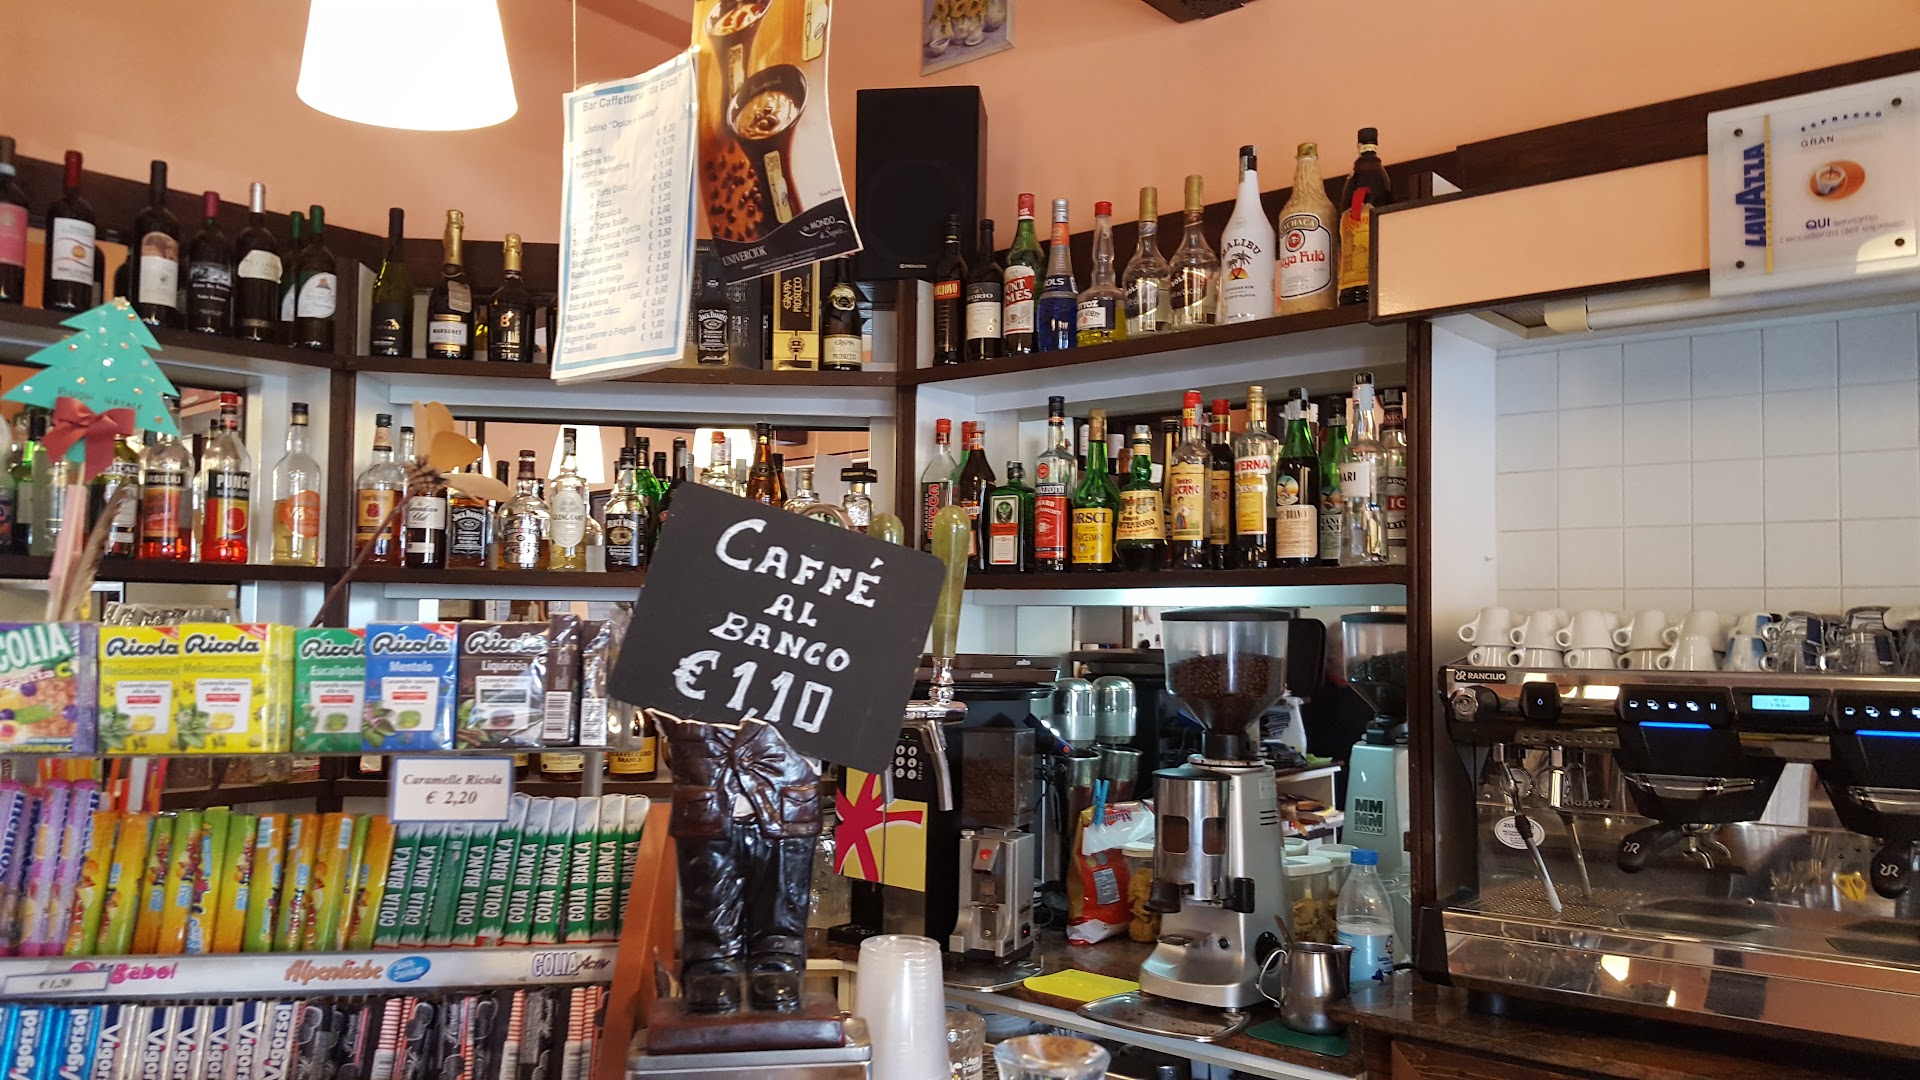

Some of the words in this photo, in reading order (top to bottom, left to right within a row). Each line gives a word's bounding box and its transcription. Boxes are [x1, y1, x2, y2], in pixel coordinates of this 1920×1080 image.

[583, 102, 597, 112] Bar
[1800, 135, 1835, 148] GRAN
[1736, 142, 1767, 248] LAVAZZA
[811, 215, 836, 231] MONDO
[1805, 216, 1831, 230] QUI
[1299, 250, 1326, 263] Fulô
[782, 278, 793, 310] GRAPPA
[793, 276, 803, 313] PROSECCO
[1077, 300, 1099, 310] TTOZ
[697, 312, 710, 322] JACK
[452, 512, 466, 522] JACK
[715, 518, 885, 608] CAFFÉ
[763, 593, 819, 628] AL
[106, 636, 180, 658] Ricola
[185, 633, 261, 654] Ricola
[371, 632, 450, 655] Ricola
[708, 611, 851, 673] BANCO
[388, 661, 434, 673] Mentolo
[481, 659, 529, 673] Liquirizia
[1467, 671, 1507, 682] RANCILIO
[672, 649, 722, 701] €
[725, 660, 834, 735] 1,10
[402, 774, 463, 786] Caramelle
[464, 774, 503, 785] Ricola
[425, 791, 437, 805] €
[443, 791, 478, 805] 2,20
[1602, 800, 1611, 809] 7
[386, 847, 413, 889] BIANCA
[412, 845, 438, 888] BIANCA
[462, 845, 488, 888] BIANCA
[488, 838, 515, 881] BIANCA
[514, 843, 539, 886] BIANCA
[540, 843, 565, 886] BIANCA
[571, 841, 593, 884] BIANCA
[596, 840, 617, 883] BIANCA
[378, 893, 402, 927] GOLIA
[403, 892, 427, 926] GOLIA
[456, 892, 479, 926] GOLIA
[482, 884, 506, 918] GOLIA
[507, 889, 531, 924] GOLIA
[534, 889, 556, 924] GOLIA
[567, 887, 588, 922] GOLIA
[593, 886, 614, 921] GOLIA
[109, 961, 179, 985] Babol
[284, 959, 384, 986] Alpenliebe
[531, 952, 578, 978] GOLIA
